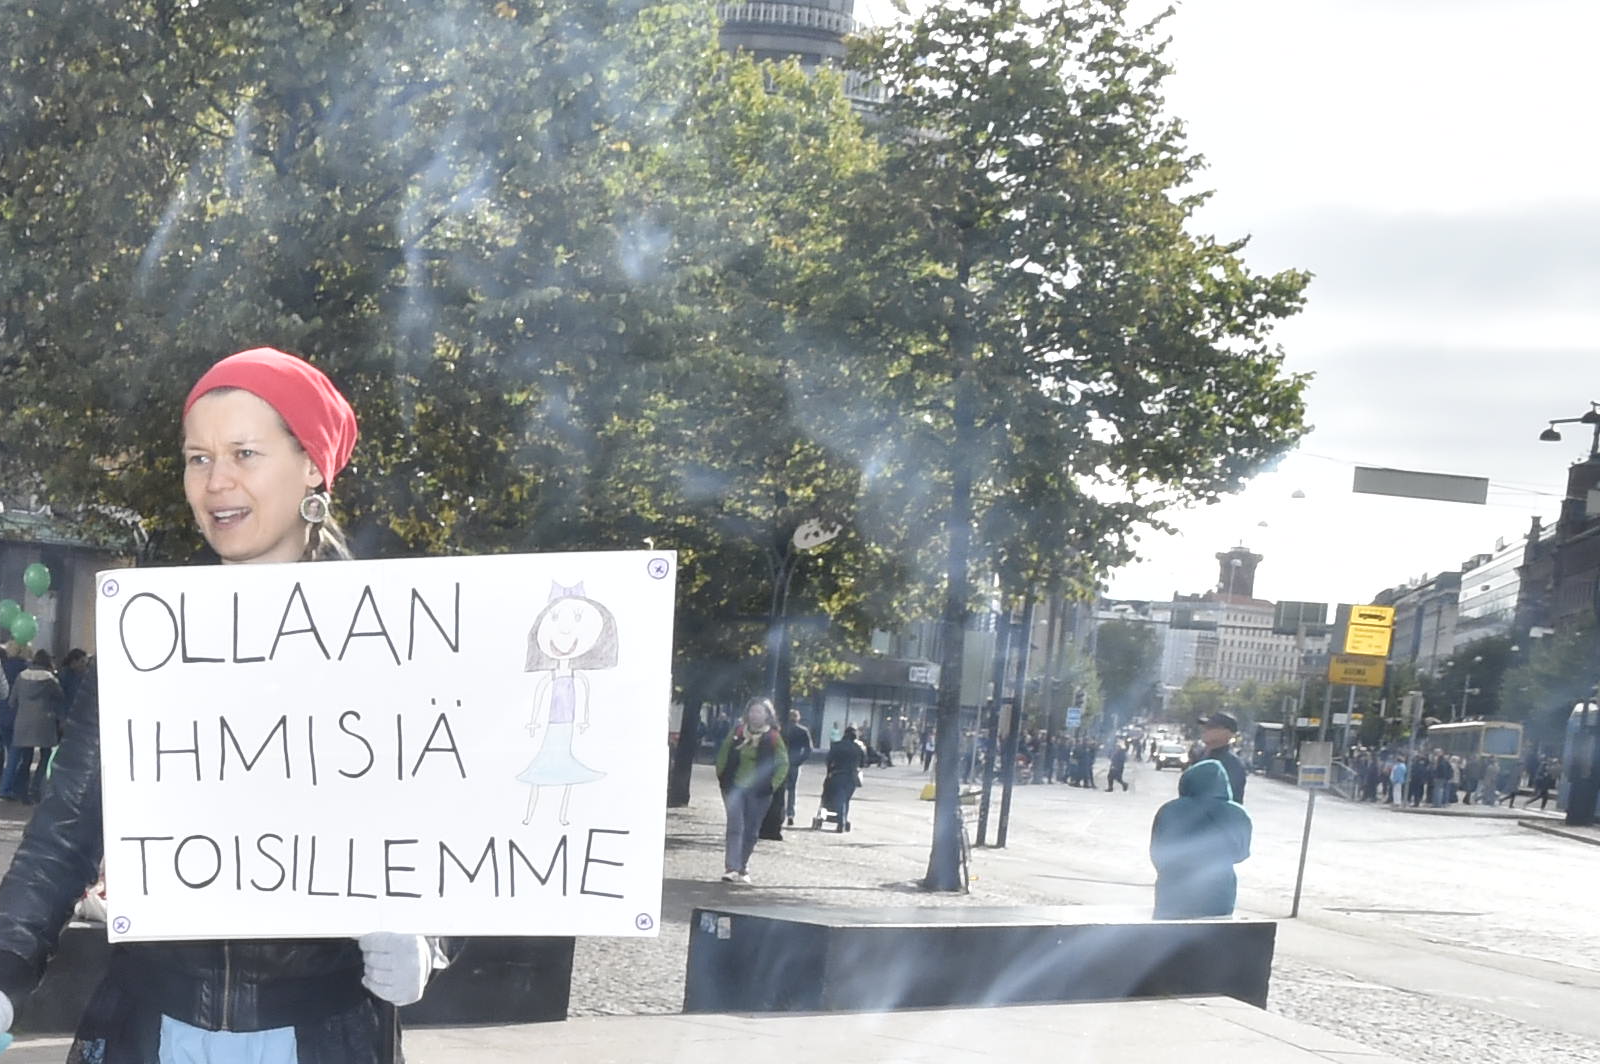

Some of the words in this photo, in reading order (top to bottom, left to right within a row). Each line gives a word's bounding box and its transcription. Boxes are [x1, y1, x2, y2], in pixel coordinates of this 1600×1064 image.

[118, 581, 462, 673] OLLAAN
[126, 698, 467, 786] IHMISIÄ
[120, 828, 631, 899] TOISILLEMME
